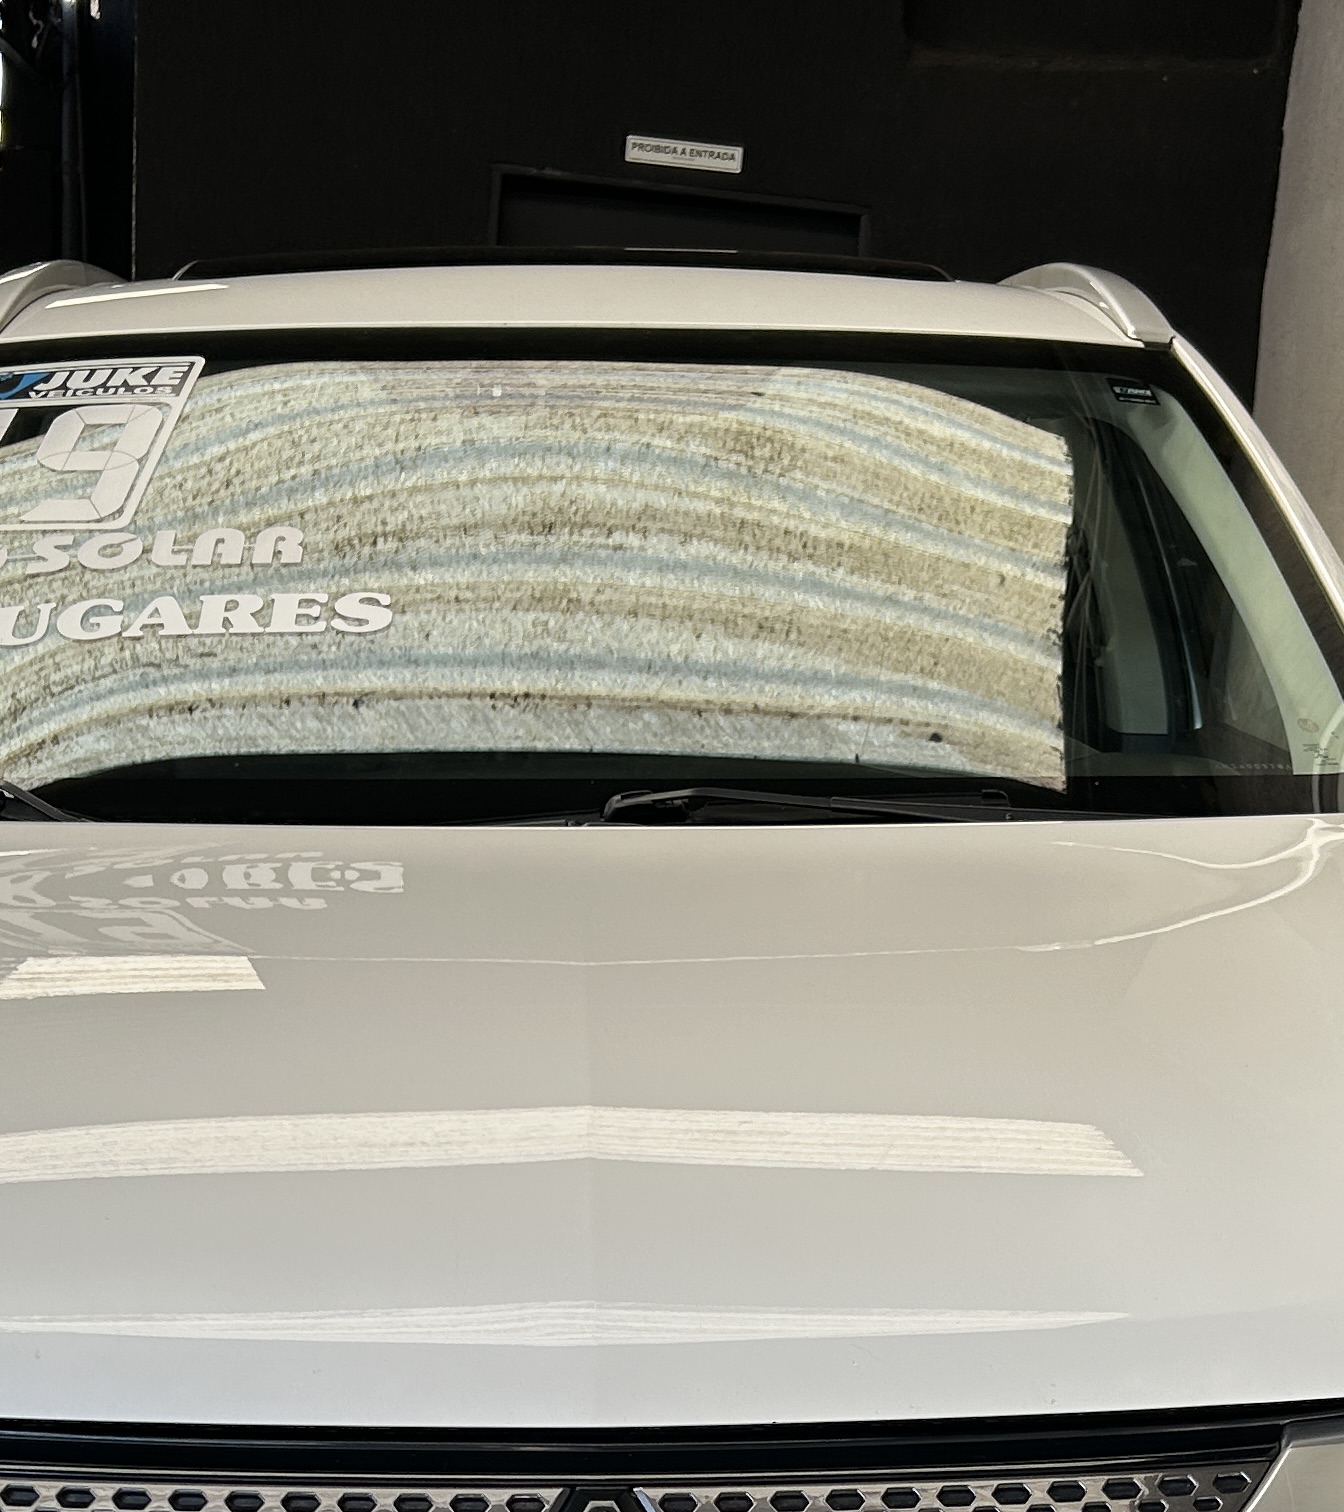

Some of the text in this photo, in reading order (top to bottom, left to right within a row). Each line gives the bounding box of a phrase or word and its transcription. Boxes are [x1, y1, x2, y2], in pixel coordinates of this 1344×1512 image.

[631, 141, 678, 155] PROIBIDA
[688, 148, 736, 162] ENTRADA
[33, 366, 190, 391] JUKE
[25, 525, 305, 575] SOLAR
